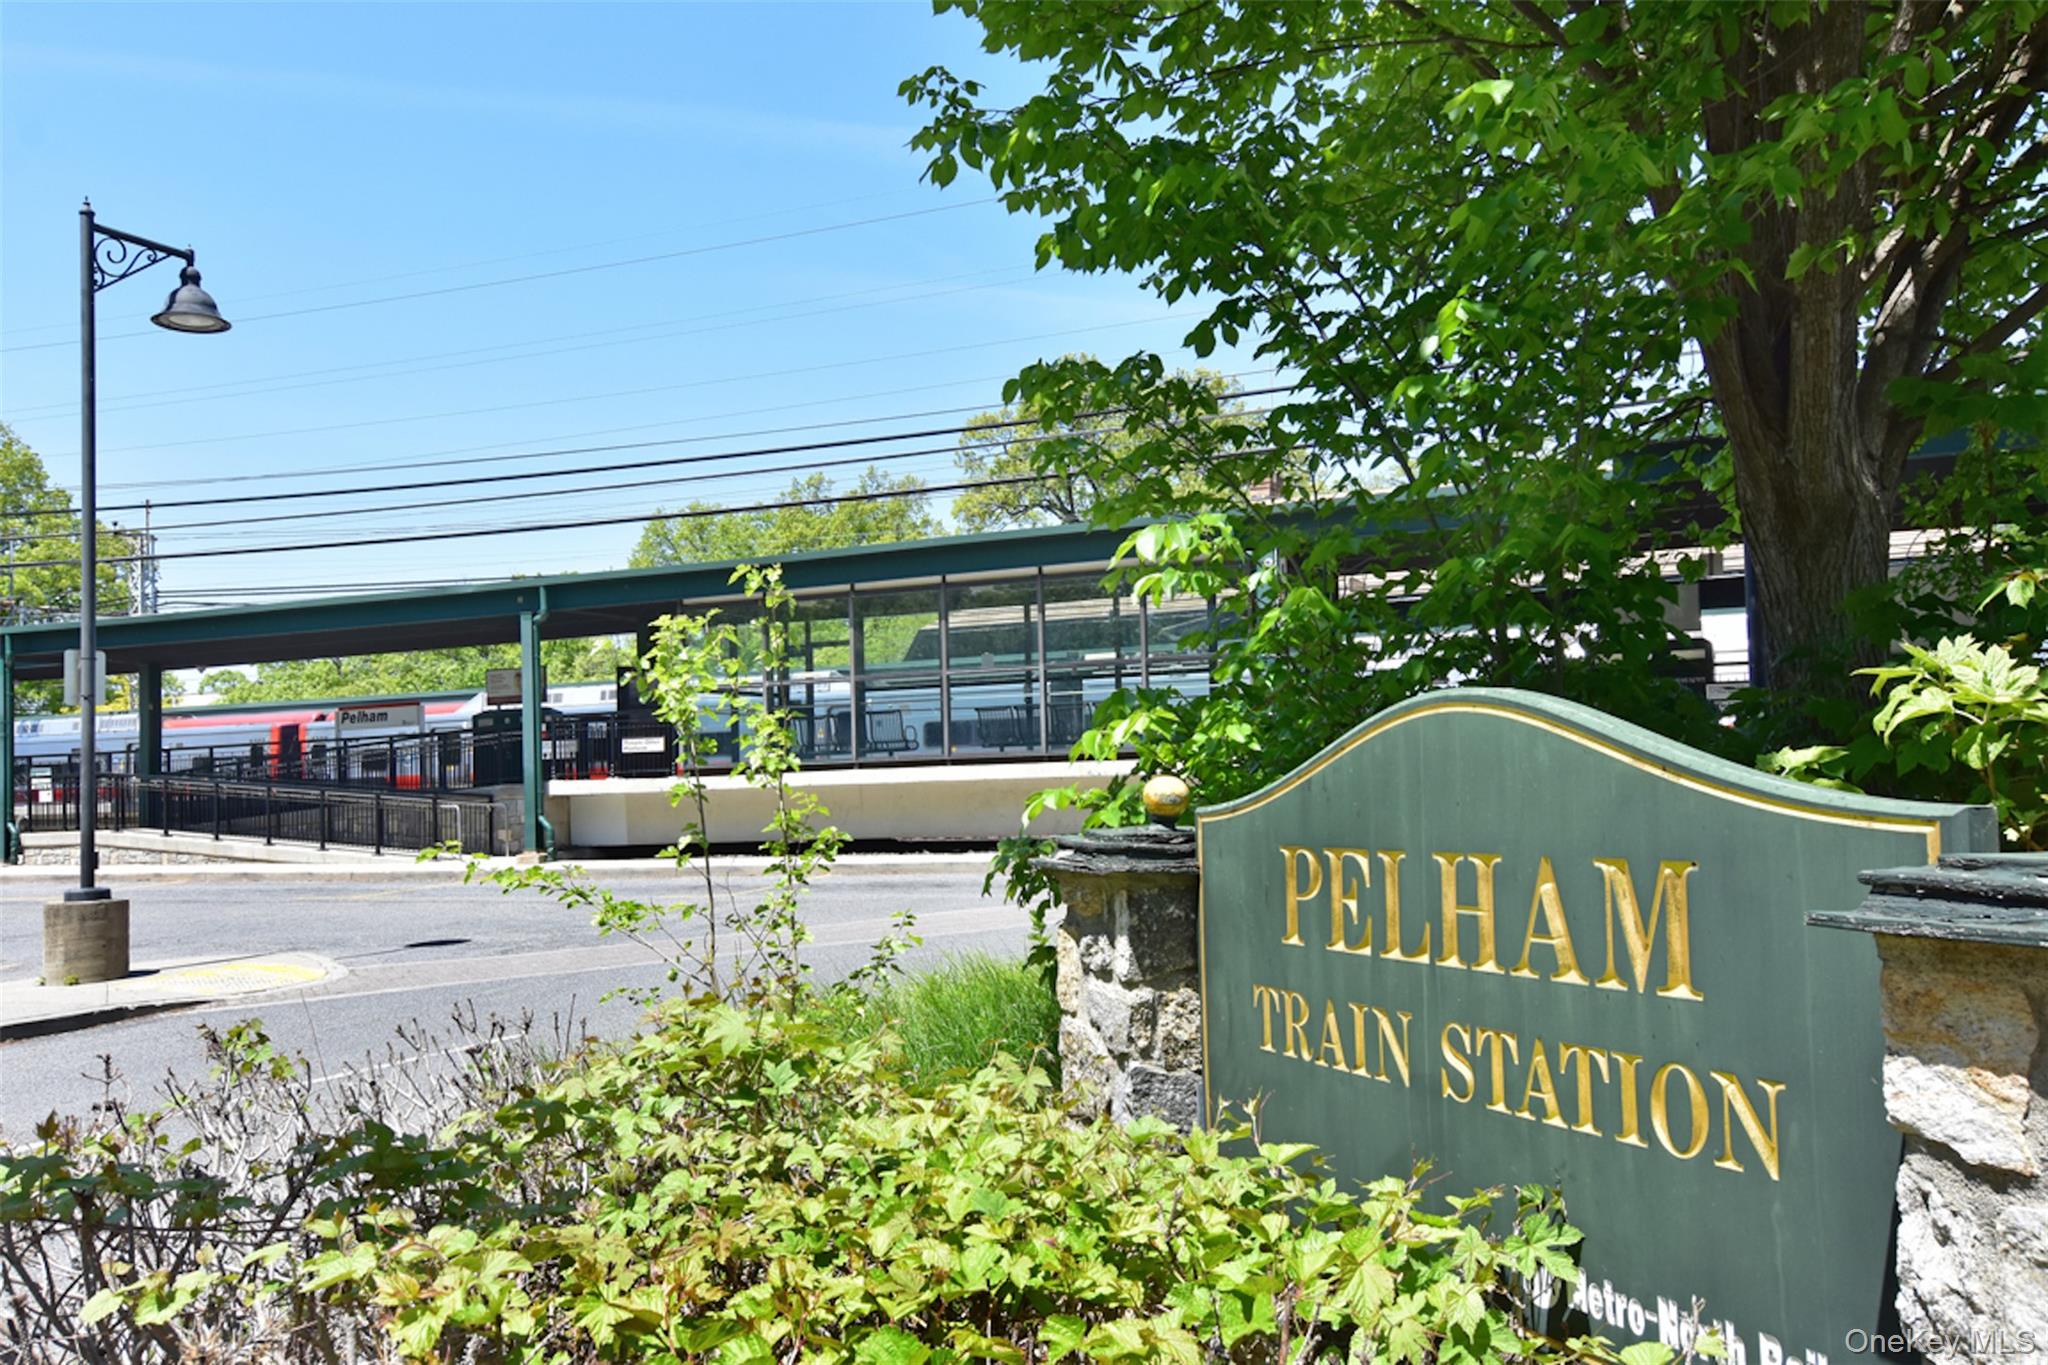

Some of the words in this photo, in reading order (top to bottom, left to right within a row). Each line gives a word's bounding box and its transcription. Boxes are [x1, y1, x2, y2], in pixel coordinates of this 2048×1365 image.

[341, 710, 388, 724] Pelham
[1279, 845, 1703, 1001] PELHAM
[1253, 984, 1413, 1088] TRAIN
[1441, 1022, 1786, 1181] STATION
